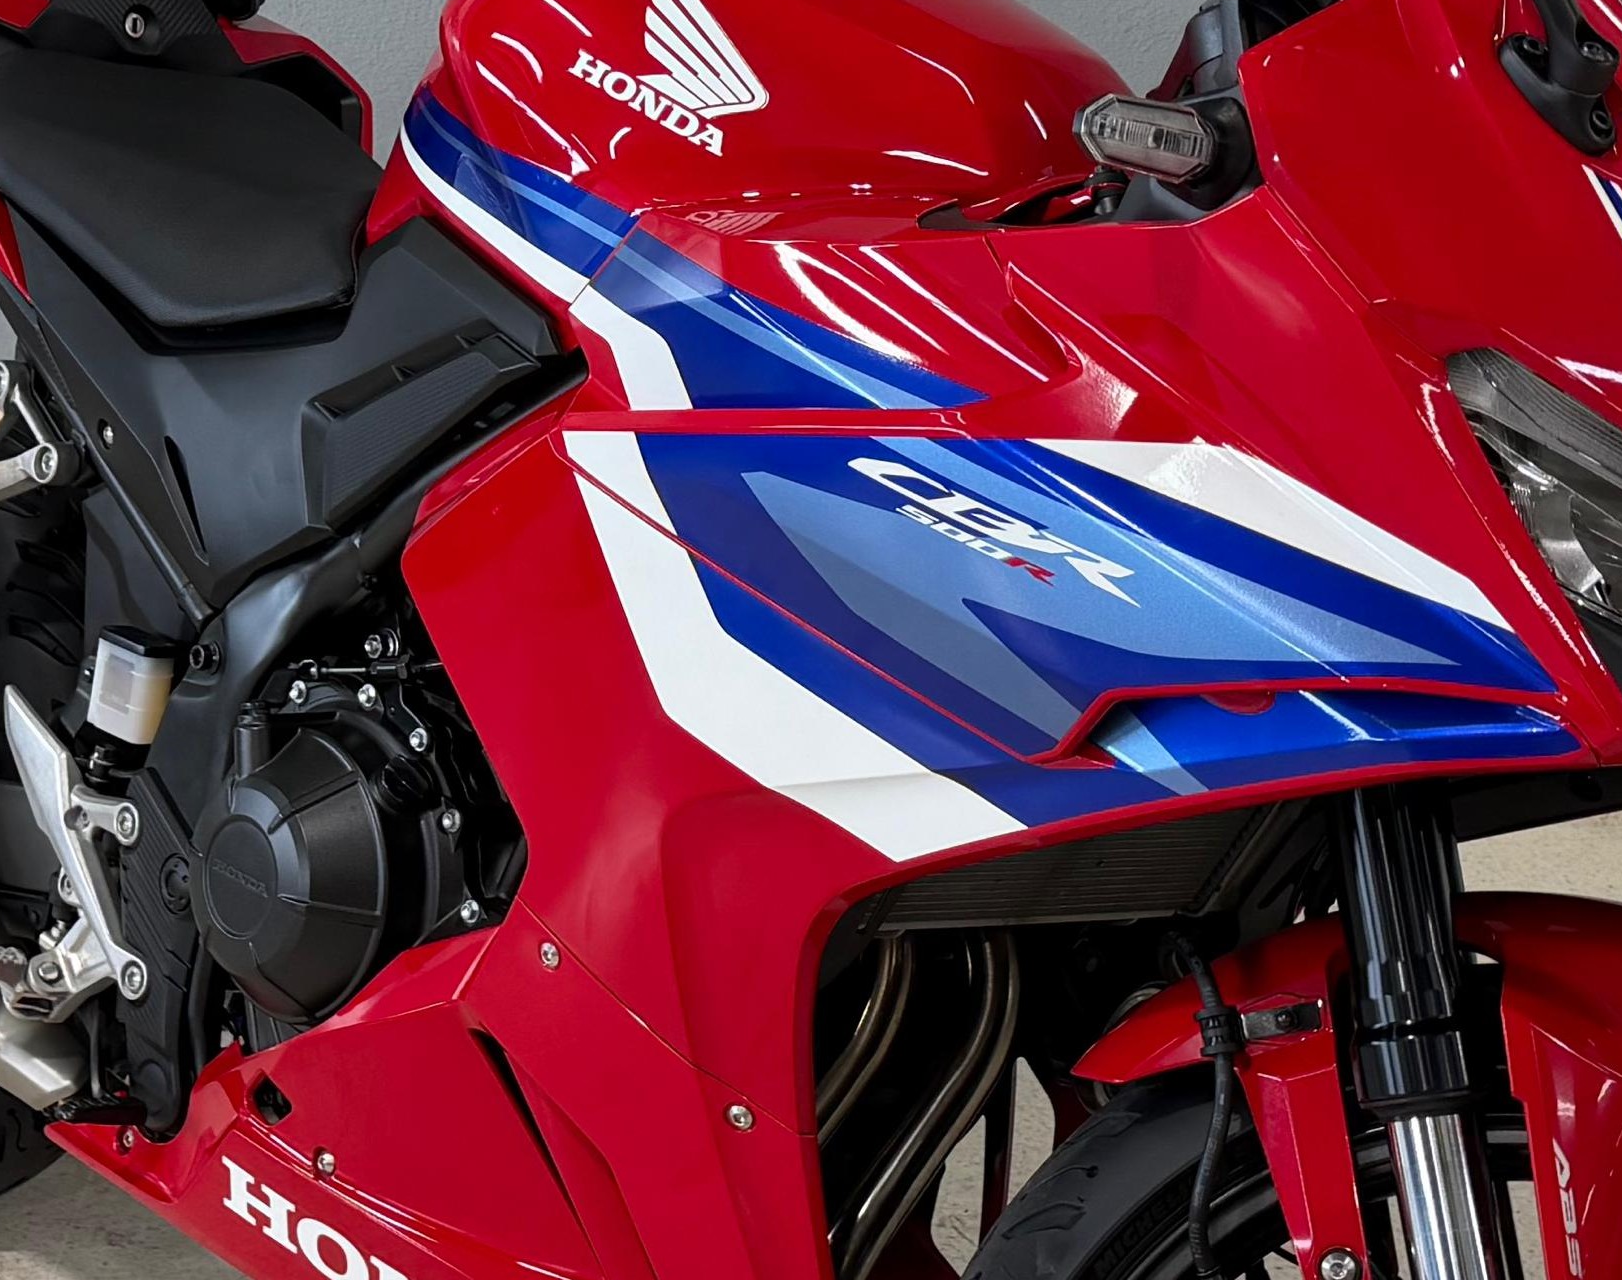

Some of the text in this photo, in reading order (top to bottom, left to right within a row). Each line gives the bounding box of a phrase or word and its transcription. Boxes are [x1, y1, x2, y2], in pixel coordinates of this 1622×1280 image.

[568, 48, 724, 157] HONDA
[847, 456, 1142, 608] CBR
[895, 504, 1056, 588] 500R
[1552, 1137, 1583, 1280] ABS
